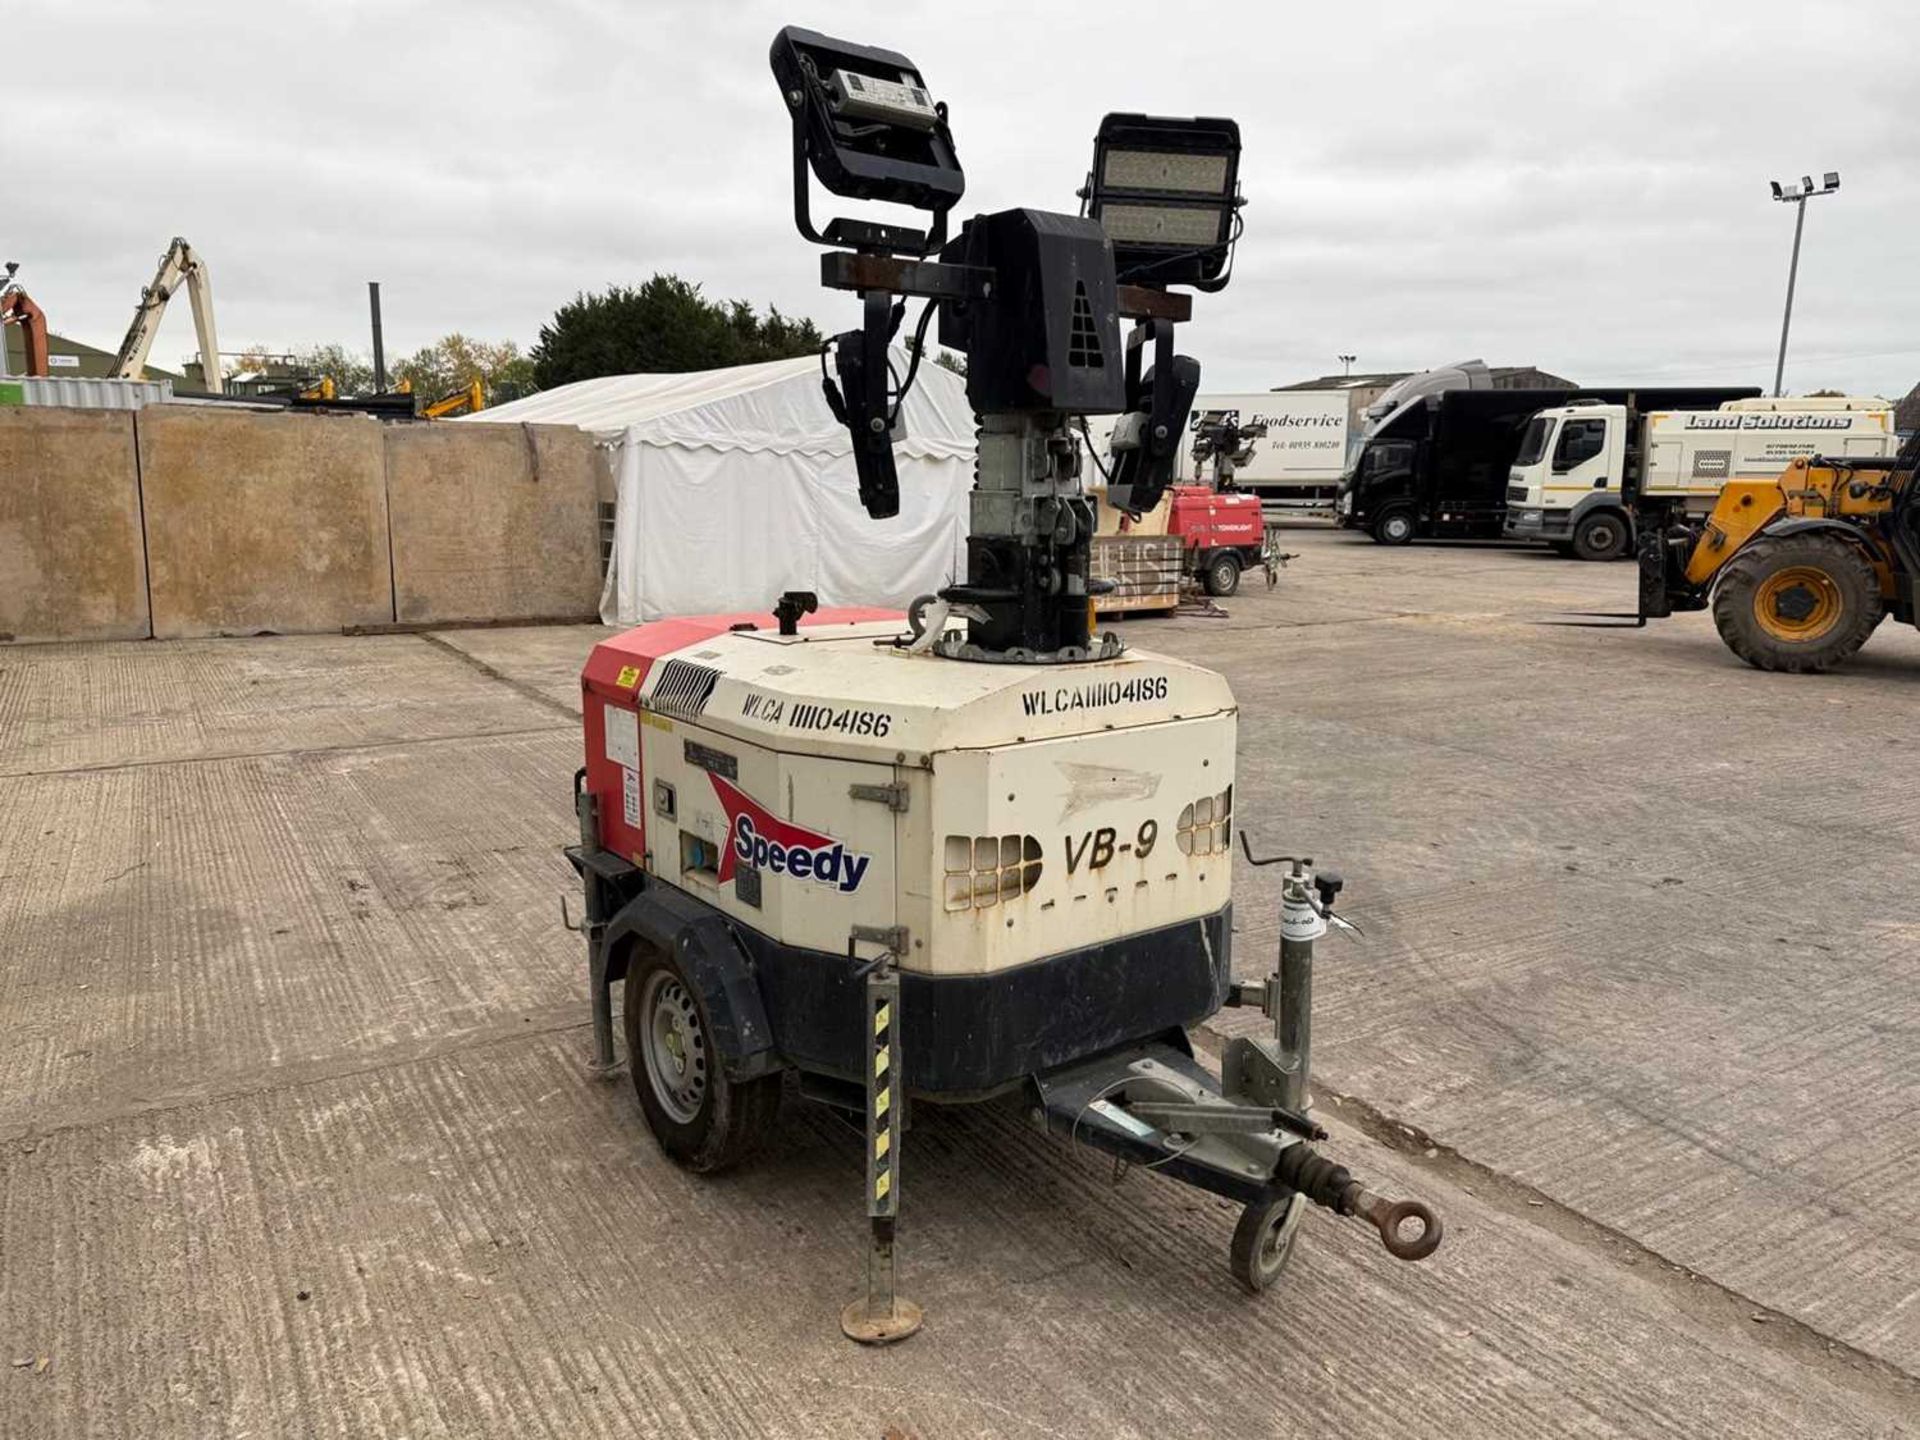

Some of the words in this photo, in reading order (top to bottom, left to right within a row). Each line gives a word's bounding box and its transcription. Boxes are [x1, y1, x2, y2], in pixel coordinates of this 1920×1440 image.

[1250, 413, 1342, 428] Foodservice
[1684, 414, 1742, 430] Land
[1743, 414, 1852, 430] Solutions
[742, 693, 785, 724] WLCA
[736, 814, 870, 892] Speedy
[1064, 819, 1158, 875] VB-9
